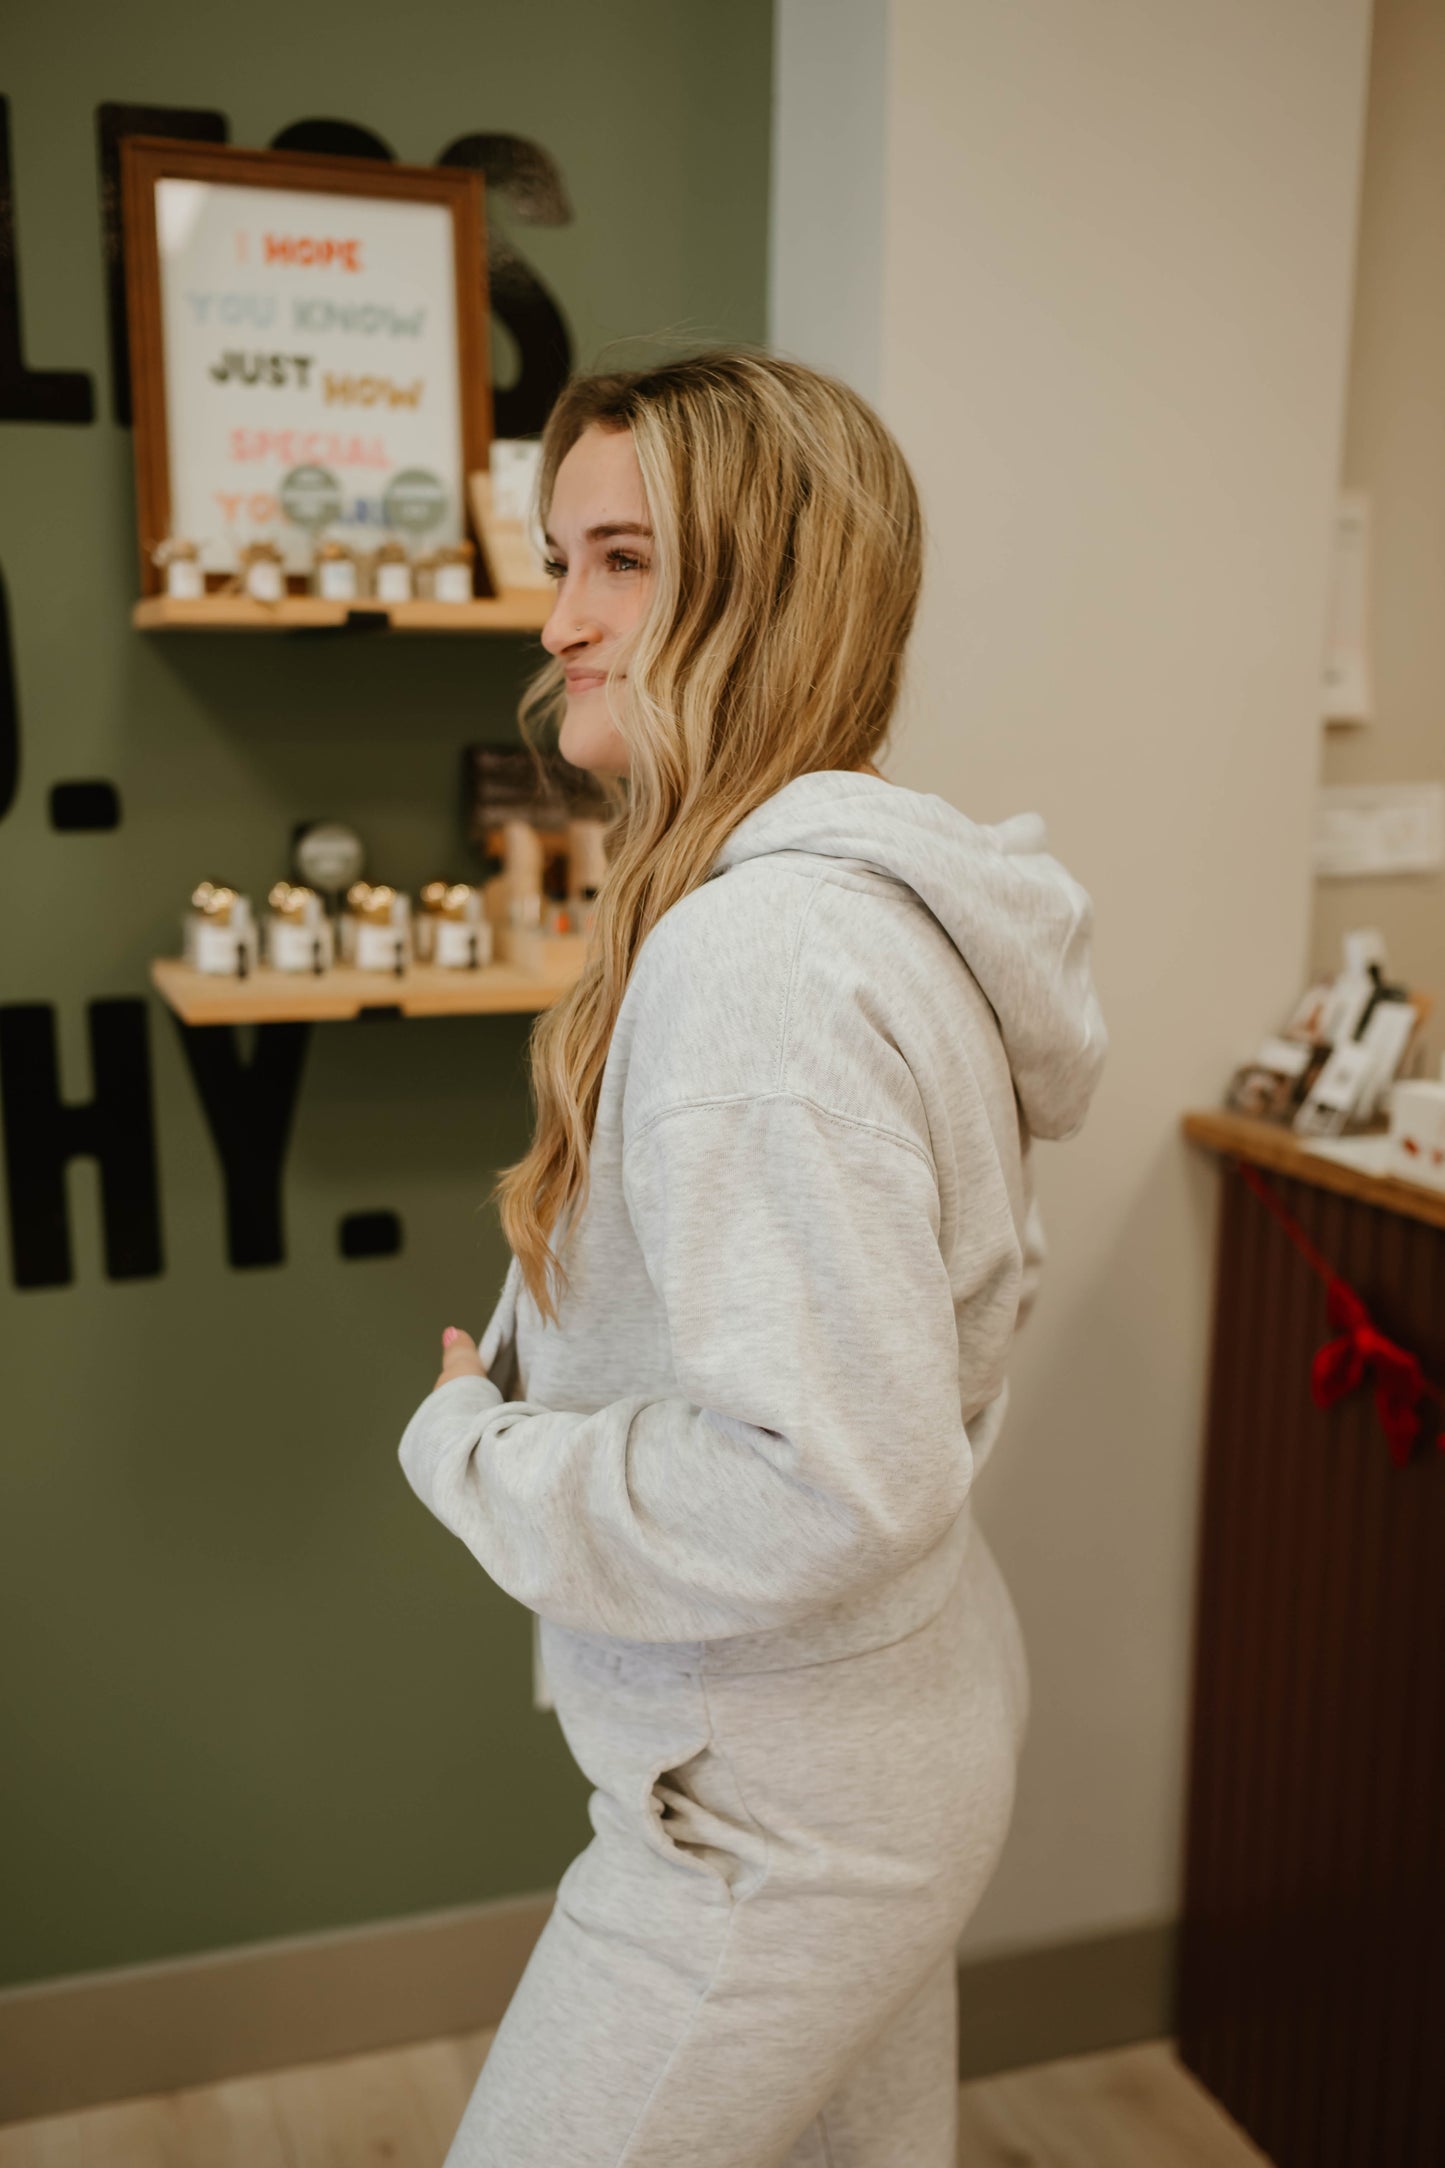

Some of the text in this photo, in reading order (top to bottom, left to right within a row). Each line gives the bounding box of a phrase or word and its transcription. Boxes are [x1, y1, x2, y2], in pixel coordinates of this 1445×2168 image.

[262, 231, 363, 274] HOPE
[187, 291, 426, 339] YOU KNOW
[208, 349, 426, 410] JUST HOW
[229, 427, 394, 469] SPECIAL
[213, 491, 302, 528] YO
